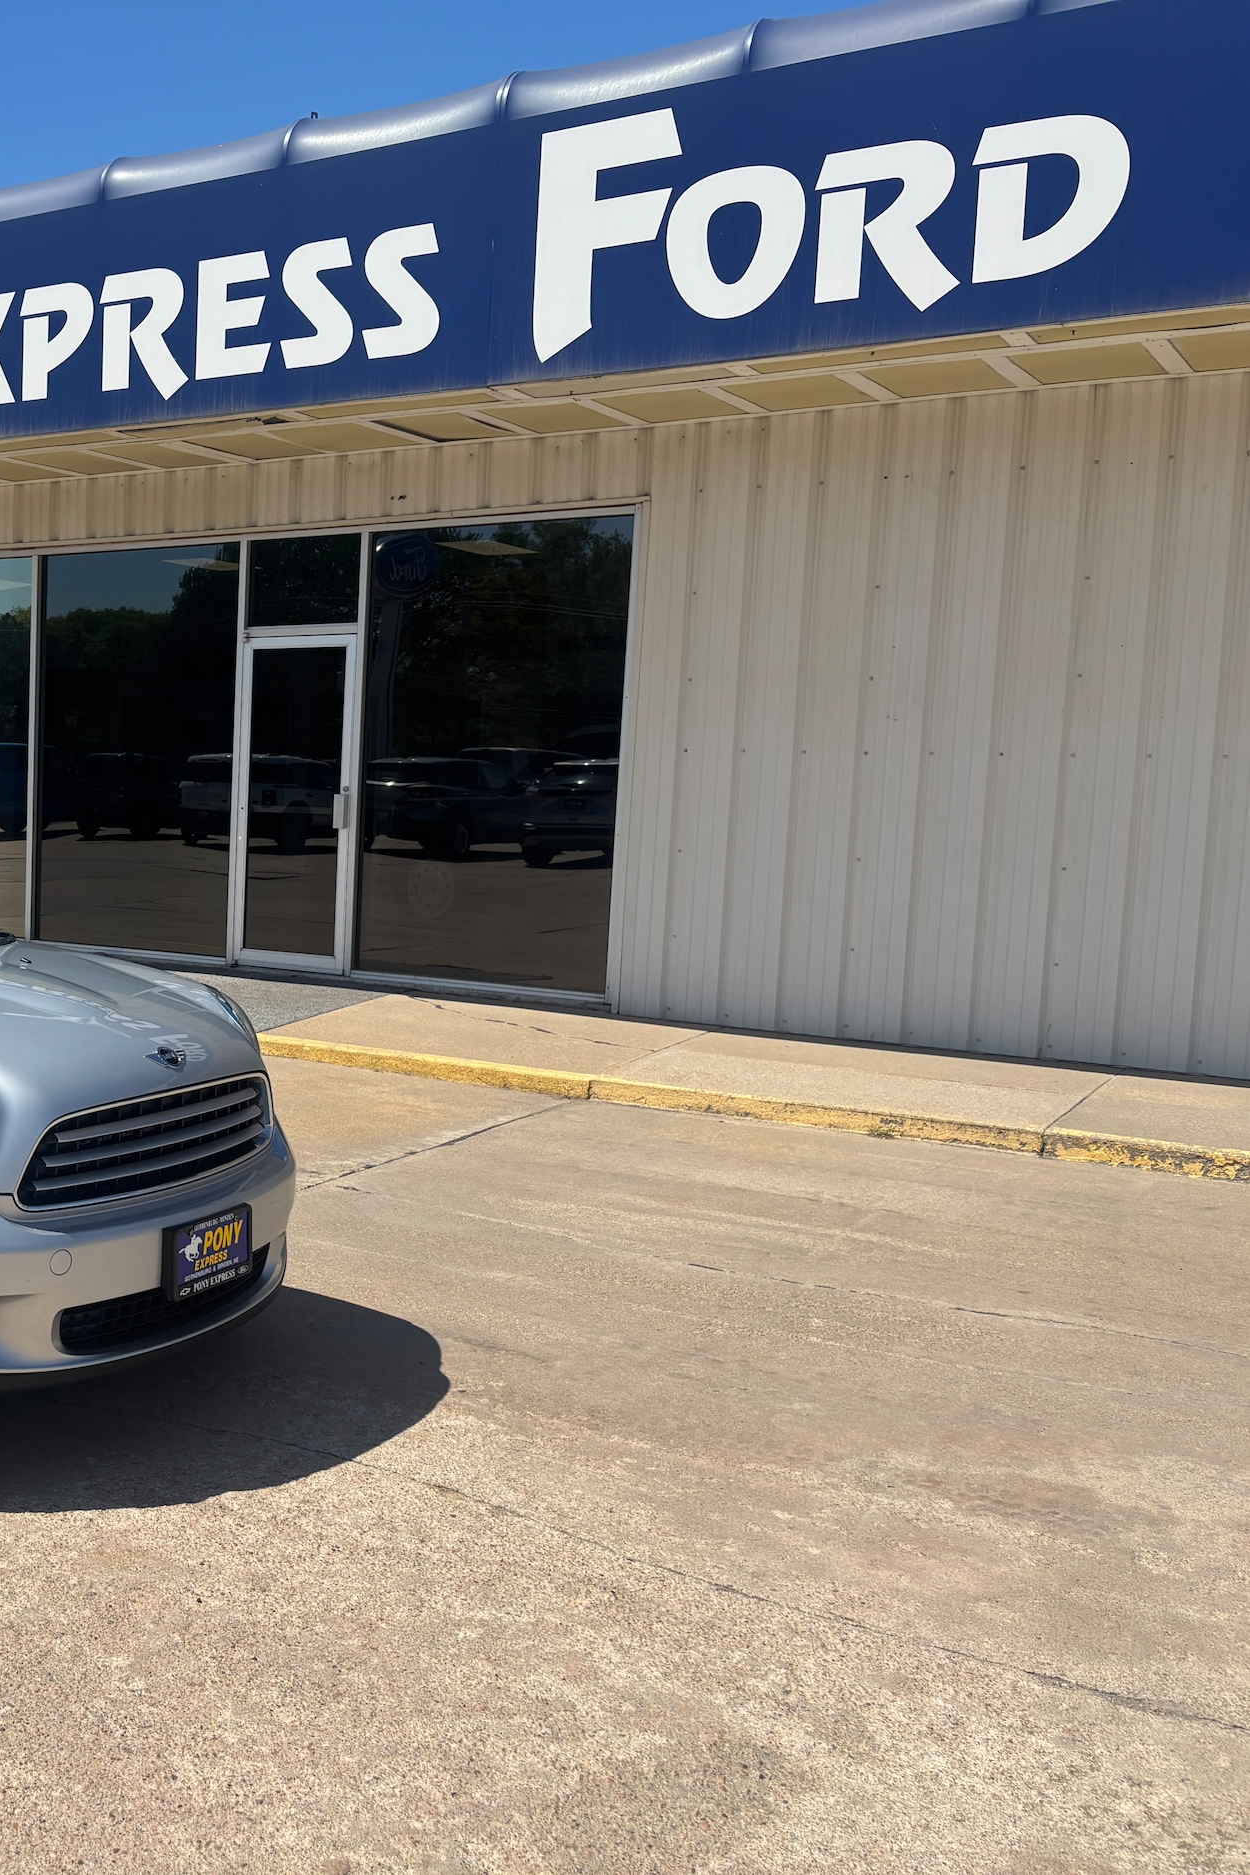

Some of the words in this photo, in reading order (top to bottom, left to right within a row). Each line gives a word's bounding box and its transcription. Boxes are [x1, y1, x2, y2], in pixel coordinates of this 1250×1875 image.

[532, 107, 1131, 364] FORD
[203, 1219, 244, 1255] PONY
[195, 1250, 228, 1271] EXPRESS
[193, 1278, 210, 1292] PONY
[210, 1268, 236, 1286] EXPRESS
